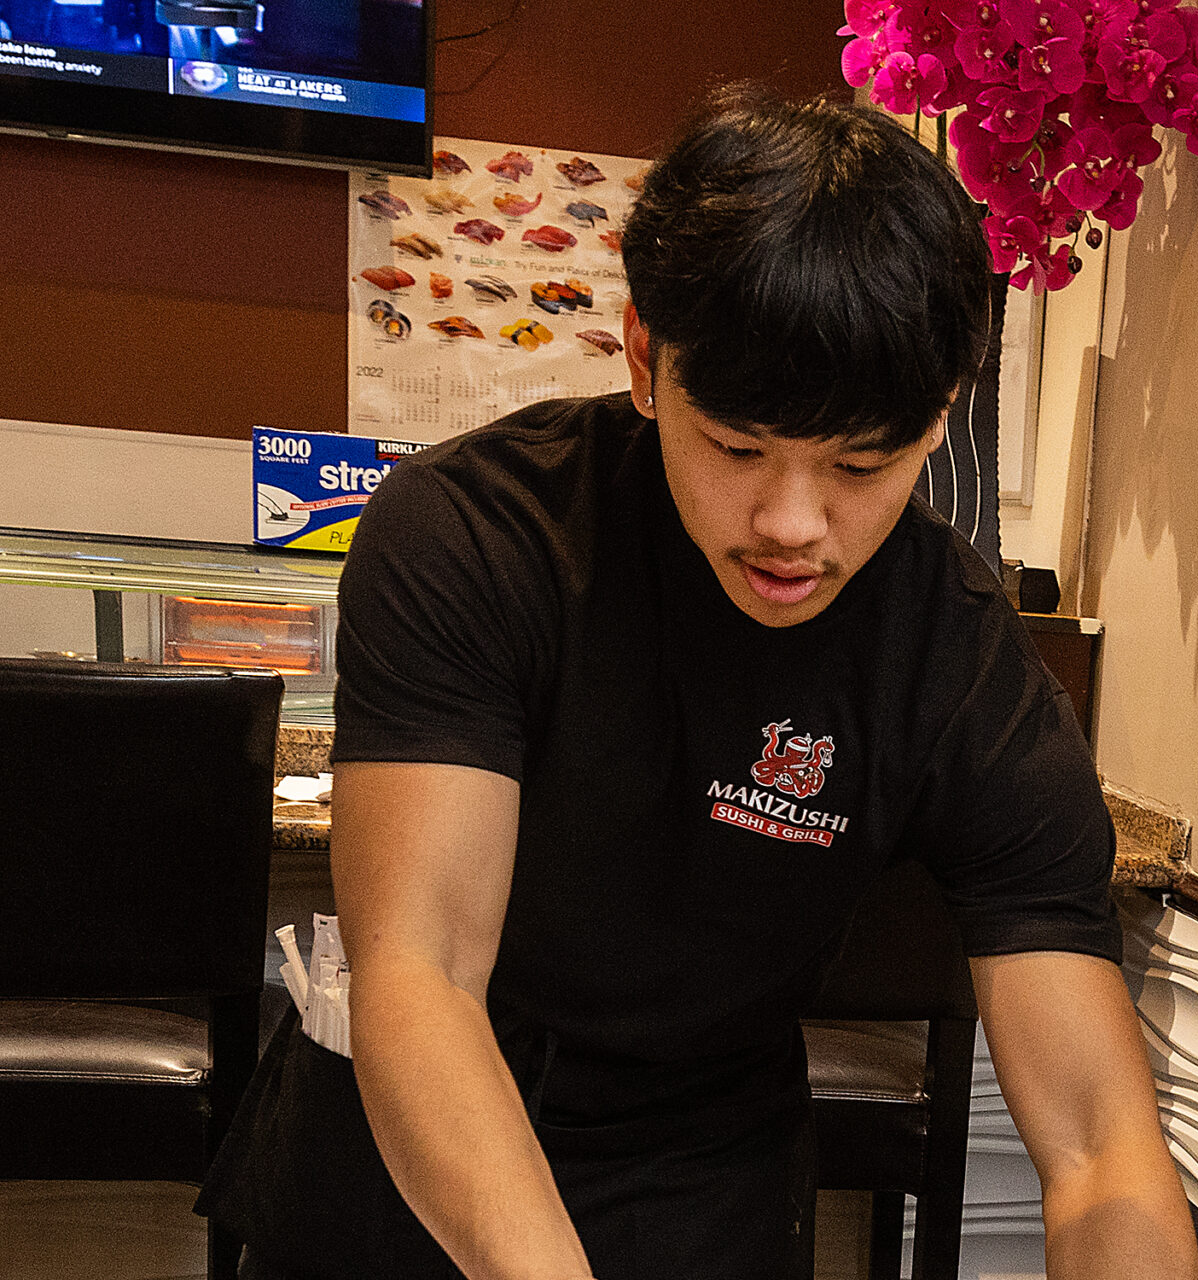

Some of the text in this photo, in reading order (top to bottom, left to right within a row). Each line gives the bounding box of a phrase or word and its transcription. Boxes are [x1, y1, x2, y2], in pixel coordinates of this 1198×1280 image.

[65, 61, 103, 76] anxiety
[238, 73, 271, 87] HEAT
[290, 79, 343, 95] LAKERS
[356, 366, 384, 378] 2022
[258, 436, 312, 458] 3000
[378, 441, 431, 455] KIRKLA
[259, 455, 310, 465] SQUARE FEET
[707, 780, 849, 833] MAKIZUSHI
[716, 806, 827, 843] SUSHI & GRILL
